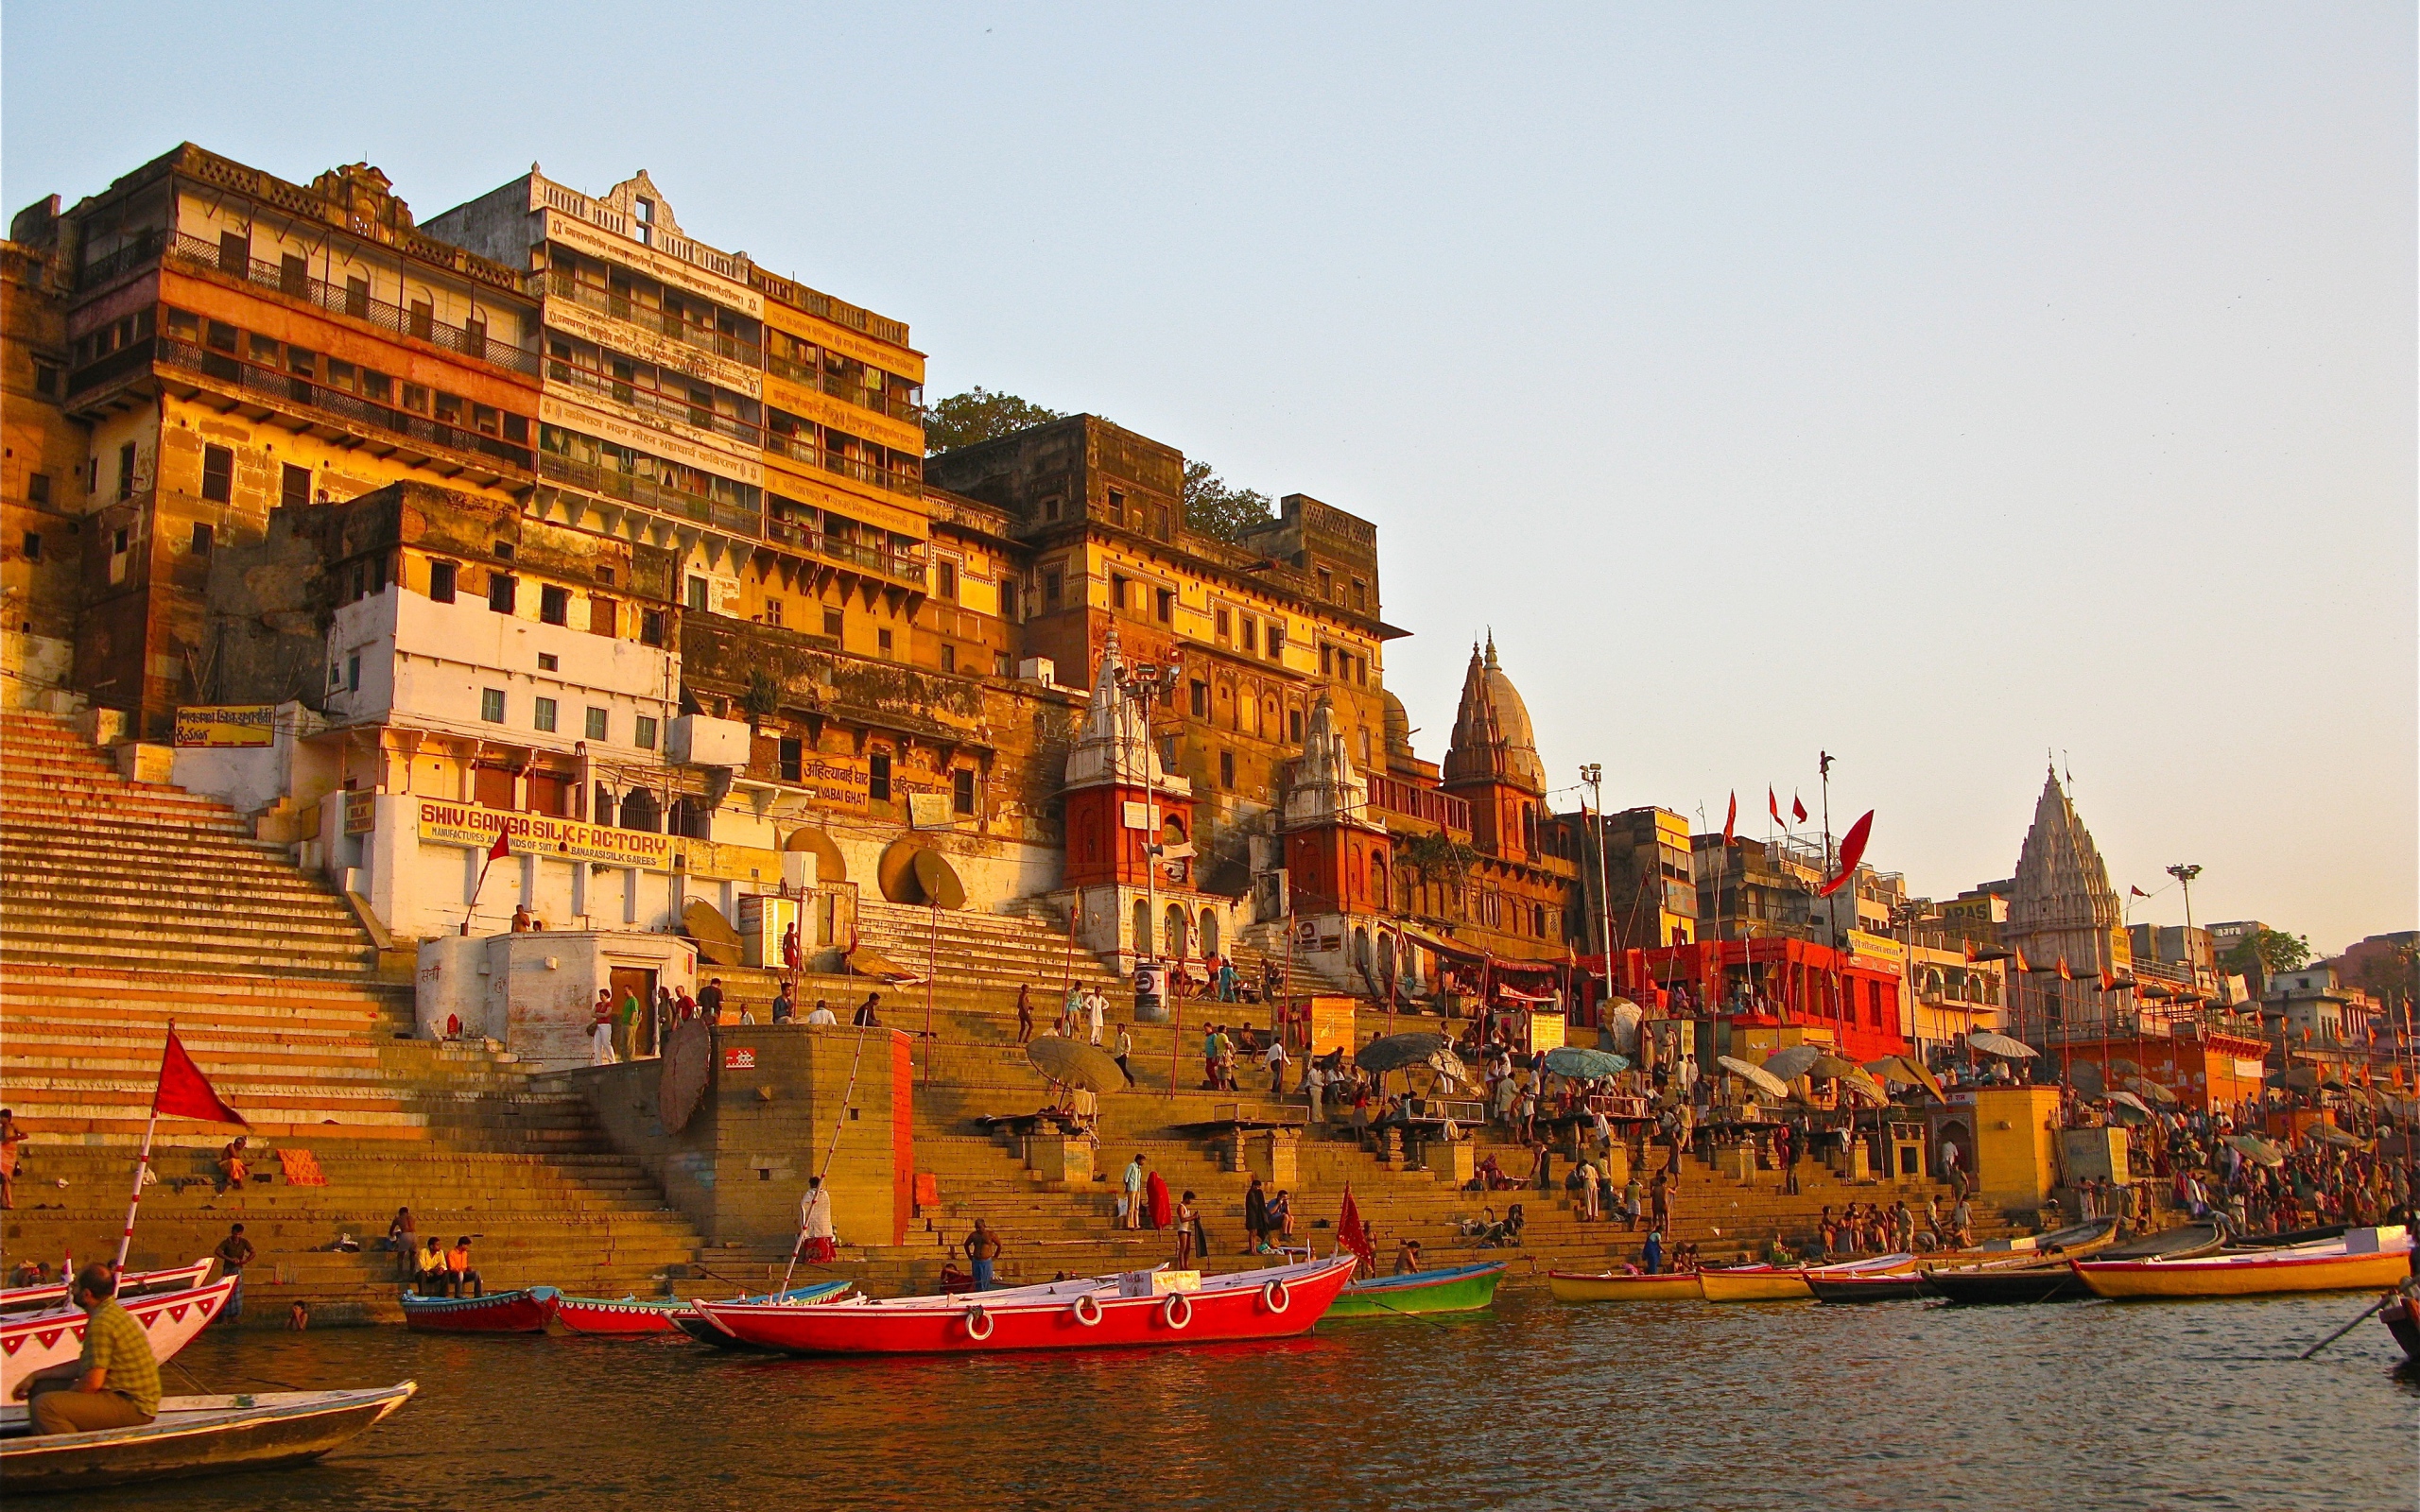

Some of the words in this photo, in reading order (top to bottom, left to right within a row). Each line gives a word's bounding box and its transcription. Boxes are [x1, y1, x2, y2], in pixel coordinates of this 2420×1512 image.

[565, 406, 604, 428] कविराज
[607, 422, 628, 436] मदन
[804, 760, 854, 785] अहिल्याबाई
[855, 770, 869, 786] घाट
[816, 785, 843, 801] LYABAI
[845, 790, 868, 806] GHAT
[421, 804, 466, 827] SHIV
[468, 812, 530, 837] GANGA
[533, 820, 576, 843] SILK
[578, 826, 667, 855] FACTORY
[431, 826, 485, 843] MANUFACTURES
[509, 838, 527, 848] INDS
[527, 840, 537, 850] OF
[539, 842, 552, 852] SUIT
[627, 854, 657, 867] SAREES
